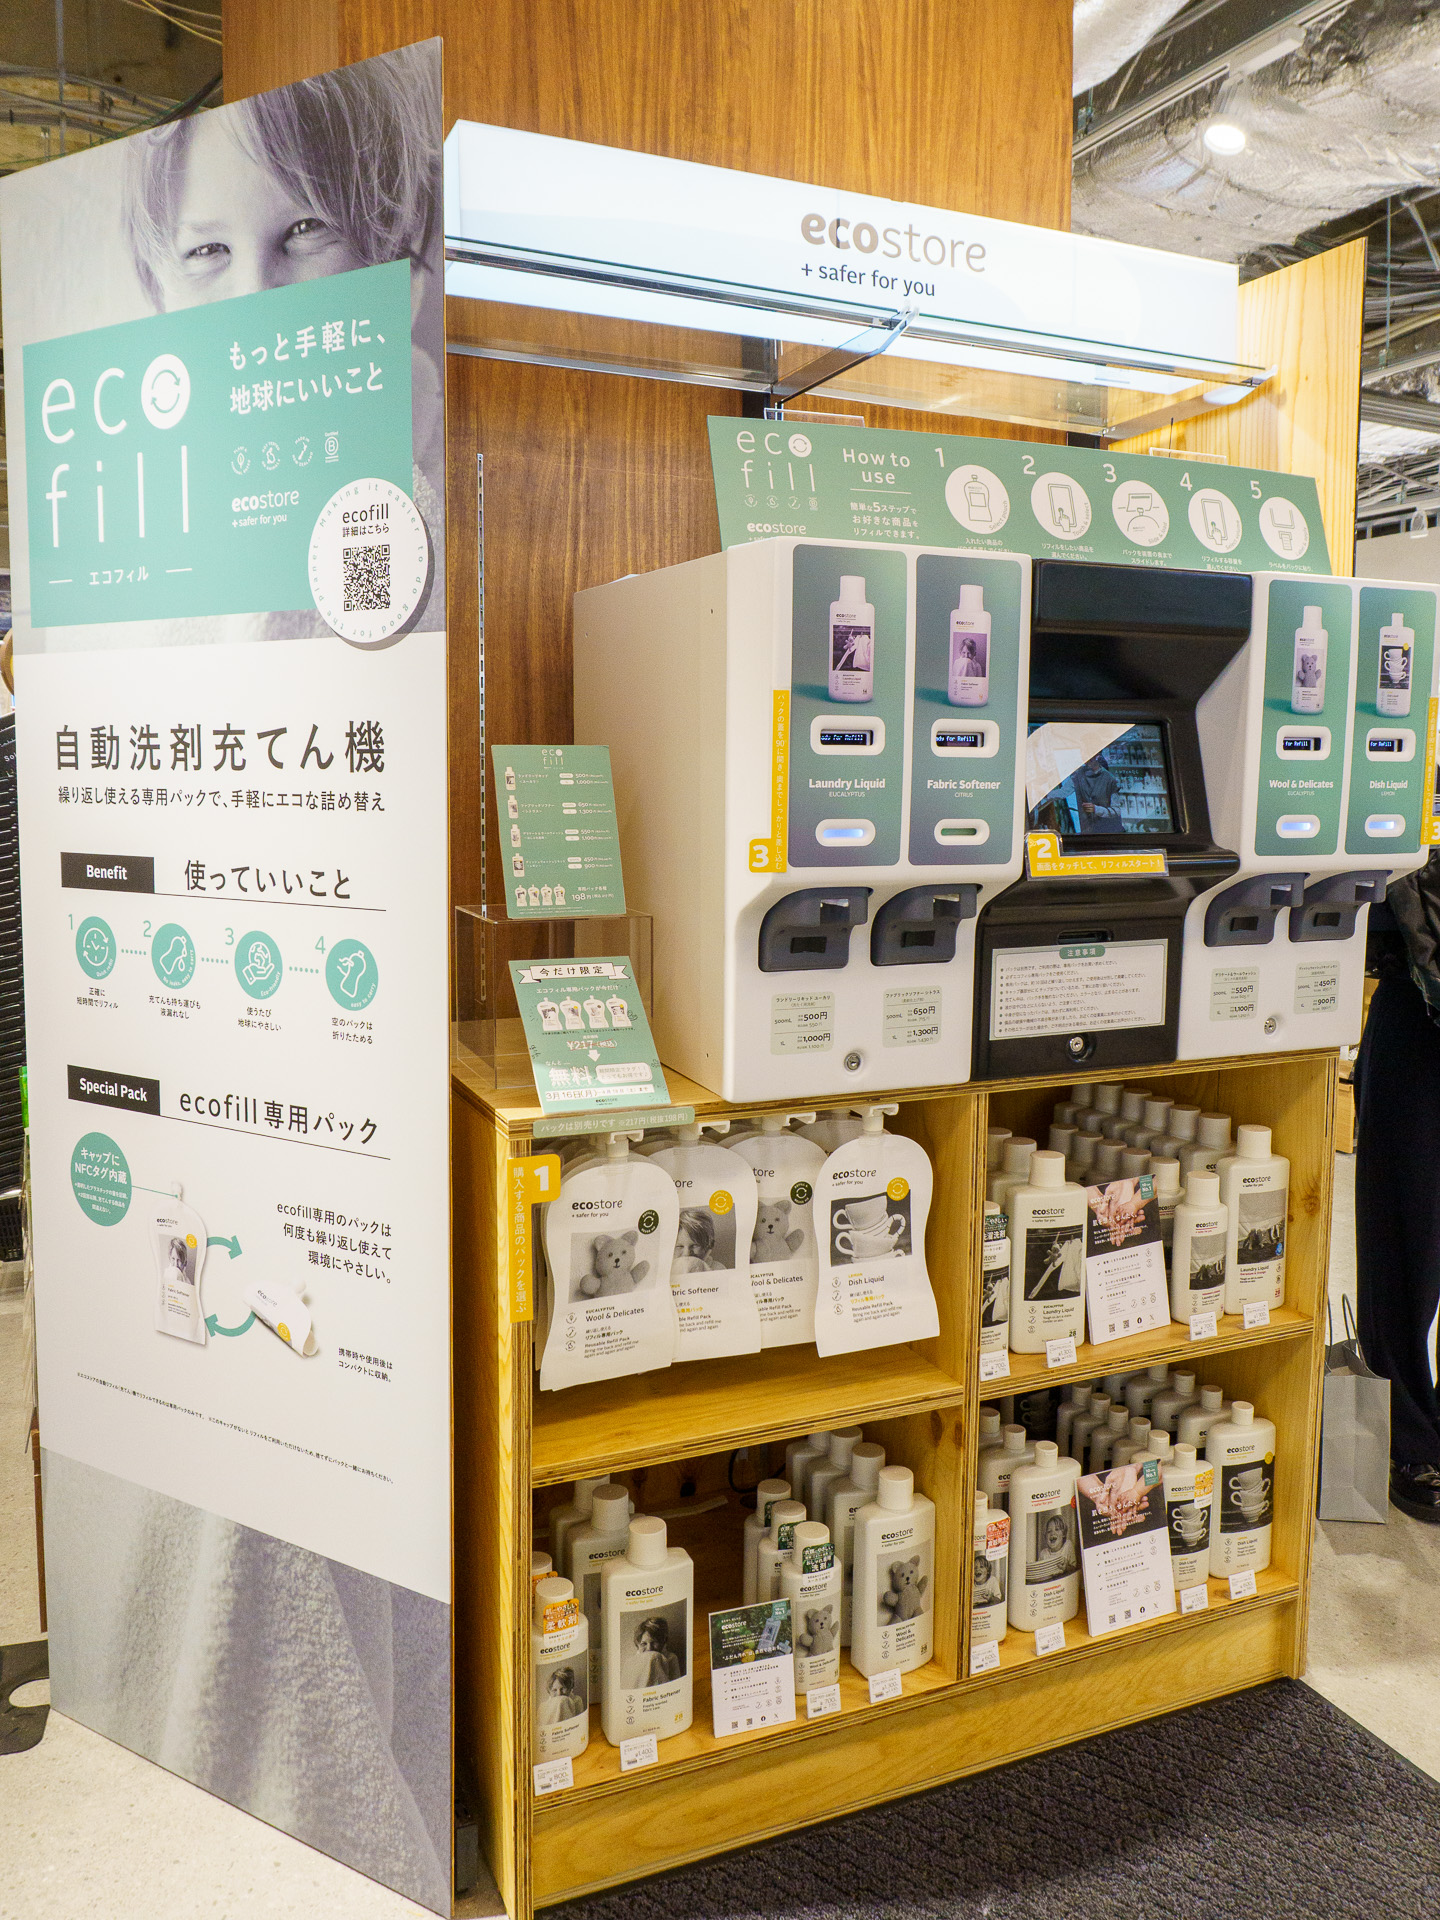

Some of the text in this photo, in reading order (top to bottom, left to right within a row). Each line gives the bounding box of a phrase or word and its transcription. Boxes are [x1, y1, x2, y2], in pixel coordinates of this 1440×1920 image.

[801, 213, 986, 272] ecostore
[819, 264, 866, 285] safer
[872, 270, 898, 290] for
[903, 279, 935, 297] you
[229, 317, 386, 371] もっと手軽に、
[229, 361, 384, 416] 地球にいいこと
[736, 430, 911, 468] eco How to
[935, 447, 944, 468] 1
[1021, 455, 1036, 476] 2
[741, 460, 816, 492] fill
[861, 471, 896, 485] use
[1102, 463, 1117, 483] 3
[1180, 472, 1193, 491] 4
[1250, 480, 1262, 499] 5
[45, 445, 189, 548] fill
[232, 490, 299, 512] ecostore
[259, 514, 271, 524] for
[273, 514, 287, 525] you
[342, 503, 389, 524] ecofill
[342, 523, 390, 538] 詳細はこちら
[746, 522, 807, 535] ecostore
[89, 566, 149, 586] エコフィル
[56, 721, 386, 773] 自動洗剤充てん機
[809, 778, 886, 791] Laundry Liquid
[927, 779, 1001, 790] Fabric Softener
[1269, 780, 1334, 789] Wool & Delicates
[1370, 780, 1408, 790] Dish Liquid
[1037, 838, 1052, 859] 2
[752, 845, 769, 868] 3
[86, 859, 351, 899] Benefit 使っていいこと
[68, 914, 74, 930] 1
[143, 920, 152, 938] 2
[225, 928, 235, 946] 3
[315, 936, 326, 954] 4
[1067, 947, 1097, 957] 注意事項
[540, 966, 604, 976] 今だけ限定
[1235, 984, 1254, 994] 550円
[1319, 978, 1337, 987] 450円
[88, 987, 106, 997] 正確に
[76, 996, 119, 1009] 短時間でリフィル
[1317, 996, 1336, 1005] 900円
[160, 1007, 190, 1019] 液漏れなし
[246, 1006, 272, 1017] 使うたび
[913, 1005, 936, 1016] 650円
[1234, 1003, 1255, 1012] 1,100円
[803, 1012, 828, 1022] 500円
[237, 1019, 282, 1031] 地球にやさしい
[912, 1026, 939, 1037] 1,300円
[332, 1031, 373, 1044] 折りたためる
[802, 1033, 831, 1043] 1,000円
[548, 1065, 593, 1087] 無料
[79, 1077, 118, 1098] Special
[120, 1084, 147, 1102] Pack
[541, 1118, 616, 1133] パックは別売りです
[81, 1147, 120, 1166] キャップに
[74, 1162, 127, 1185] NFCタグ内蔵
[534, 1165, 550, 1191] 1
[832, 1168, 877, 1180] ecostore
[1242, 1175, 1271, 1184] ecostore
[571, 1199, 623, 1211] ecostore
[1032, 1207, 1065, 1216] ecostore
[277, 1203, 392, 1238] ecofill専用のパックは
[283, 1222, 392, 1260] 何度も繰り返し使えて
[512, 1166, 527, 1314] 購入する商品のパックを選ぶ
[308, 1250, 391, 1284] 環境にやさしい。
[773, 1276, 804, 1285] Delicates
[864, 1275, 885, 1284] Liquid
[687, 1287, 719, 1295] Softener
[586, 1306, 615, 1314] EUCALYPTUS
[586, 1313, 604, 1322] Wool
[613, 1307, 645, 1318] Delicates
[1226, 1444, 1255, 1454] ecostore
[1031, 1488, 1061, 1500] ecostore
[881, 1528, 914, 1540] ecostore
[588, 1548, 626, 1560] ecostore
[625, 1585, 664, 1597] ecostore
[800, 1583, 828, 1592] ecostore
[546, 1614, 577, 1632] 柔軟剤
[721, 1620, 747, 1630] ecostore
[540, 1643, 571, 1655] ecostore
[643, 1689, 681, 1703] Fabric Softener
